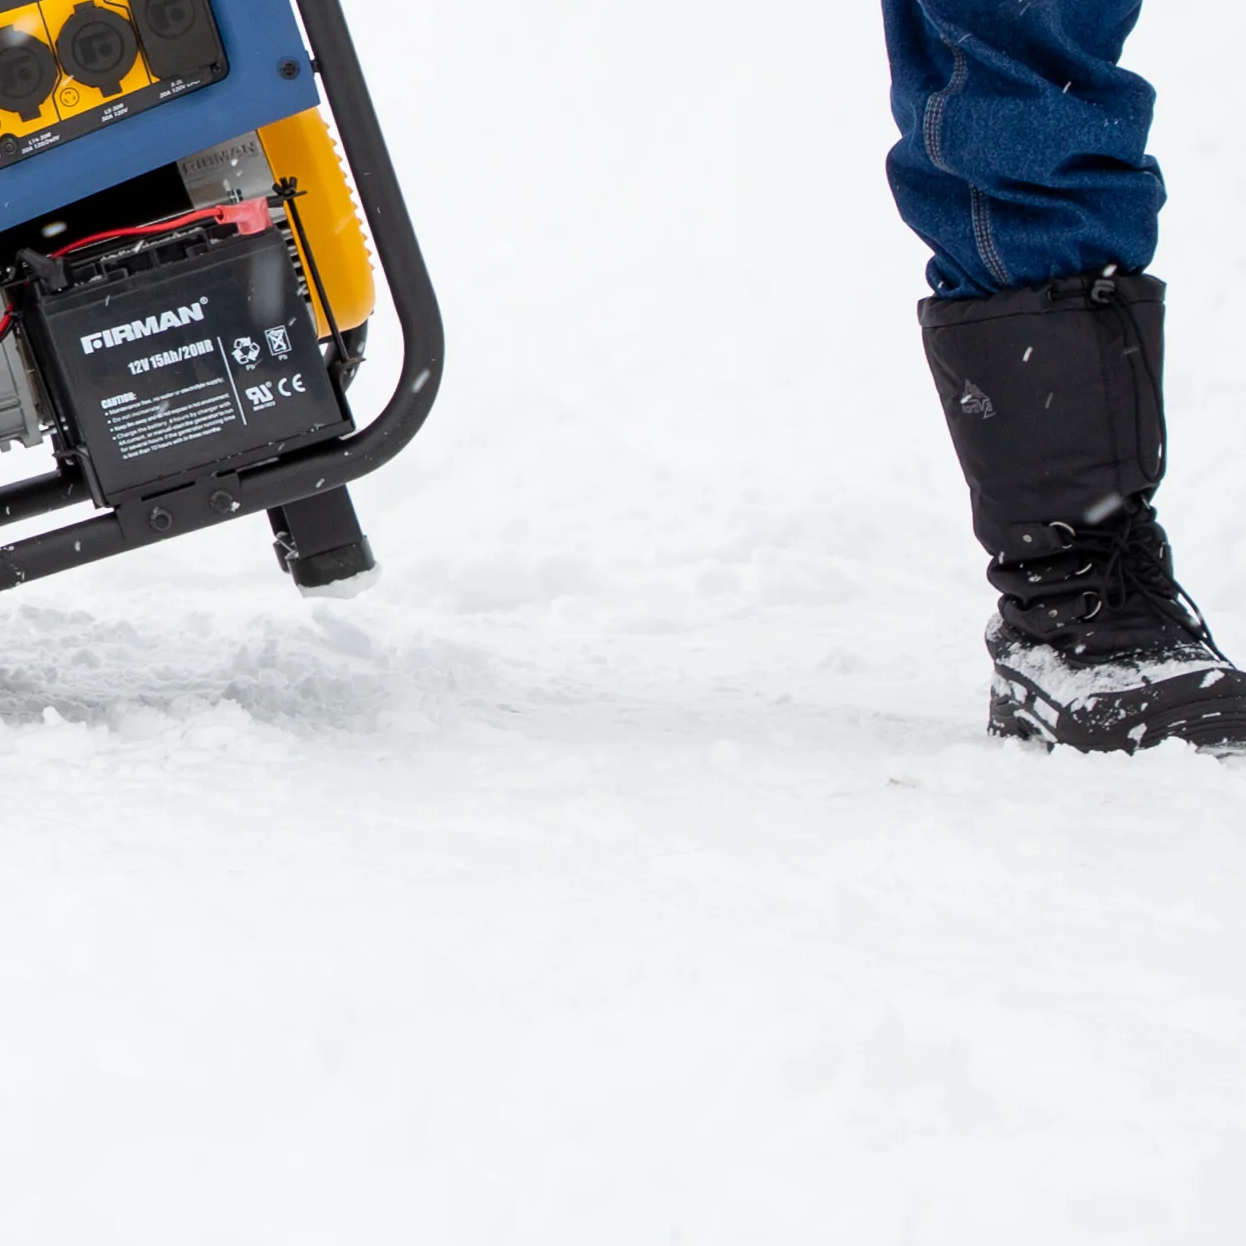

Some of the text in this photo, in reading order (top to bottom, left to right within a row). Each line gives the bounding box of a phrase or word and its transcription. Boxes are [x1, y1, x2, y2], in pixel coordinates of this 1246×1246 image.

[80, 301, 206, 355] FIRMAN
[127, 338, 215, 376] 12V 15Ah/20HR
[277, 373, 306, 397] CE
